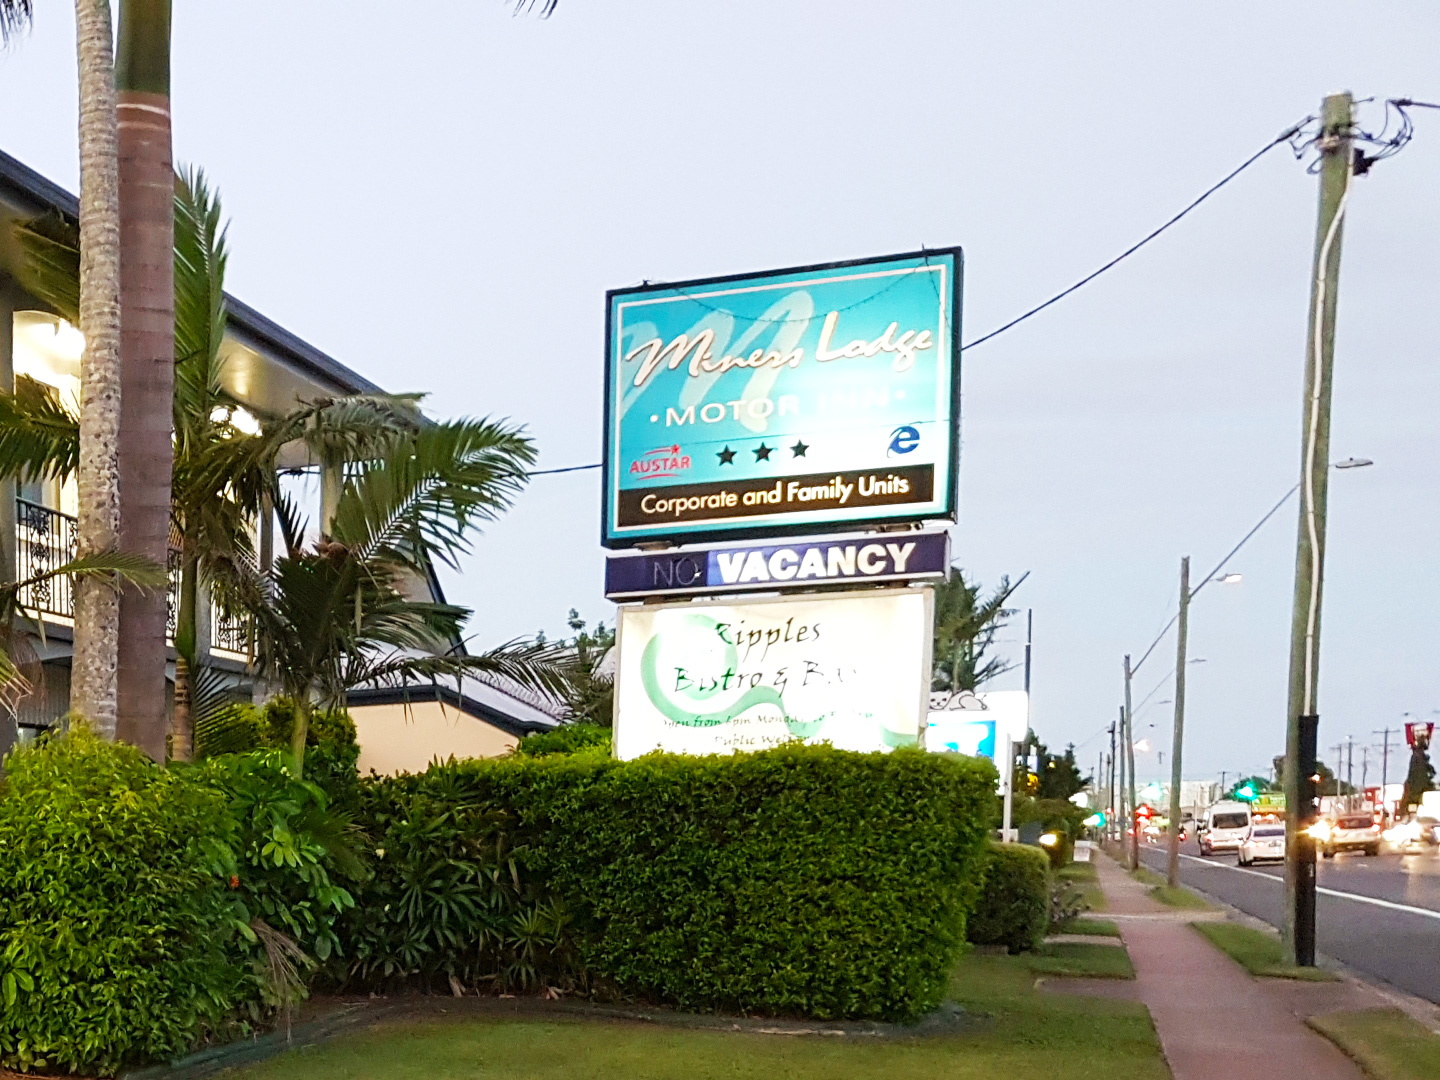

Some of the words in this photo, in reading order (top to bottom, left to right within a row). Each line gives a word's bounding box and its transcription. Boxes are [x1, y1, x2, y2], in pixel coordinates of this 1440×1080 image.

[815, 310, 934, 373] Lodge
[665, 394, 801, 428] MOTOR
[629, 455, 692, 474] AUSTAR
[641, 490, 738, 517] Corporate
[742, 480, 782, 505] and
[787, 475, 854, 504] Family
[858, 474, 910, 497] Units
[653, 556, 698, 586] NO
[716, 542, 917, 585] VACANCY
[715, 617, 821, 663] Ripples
[674, 667, 763, 692] Bistro
